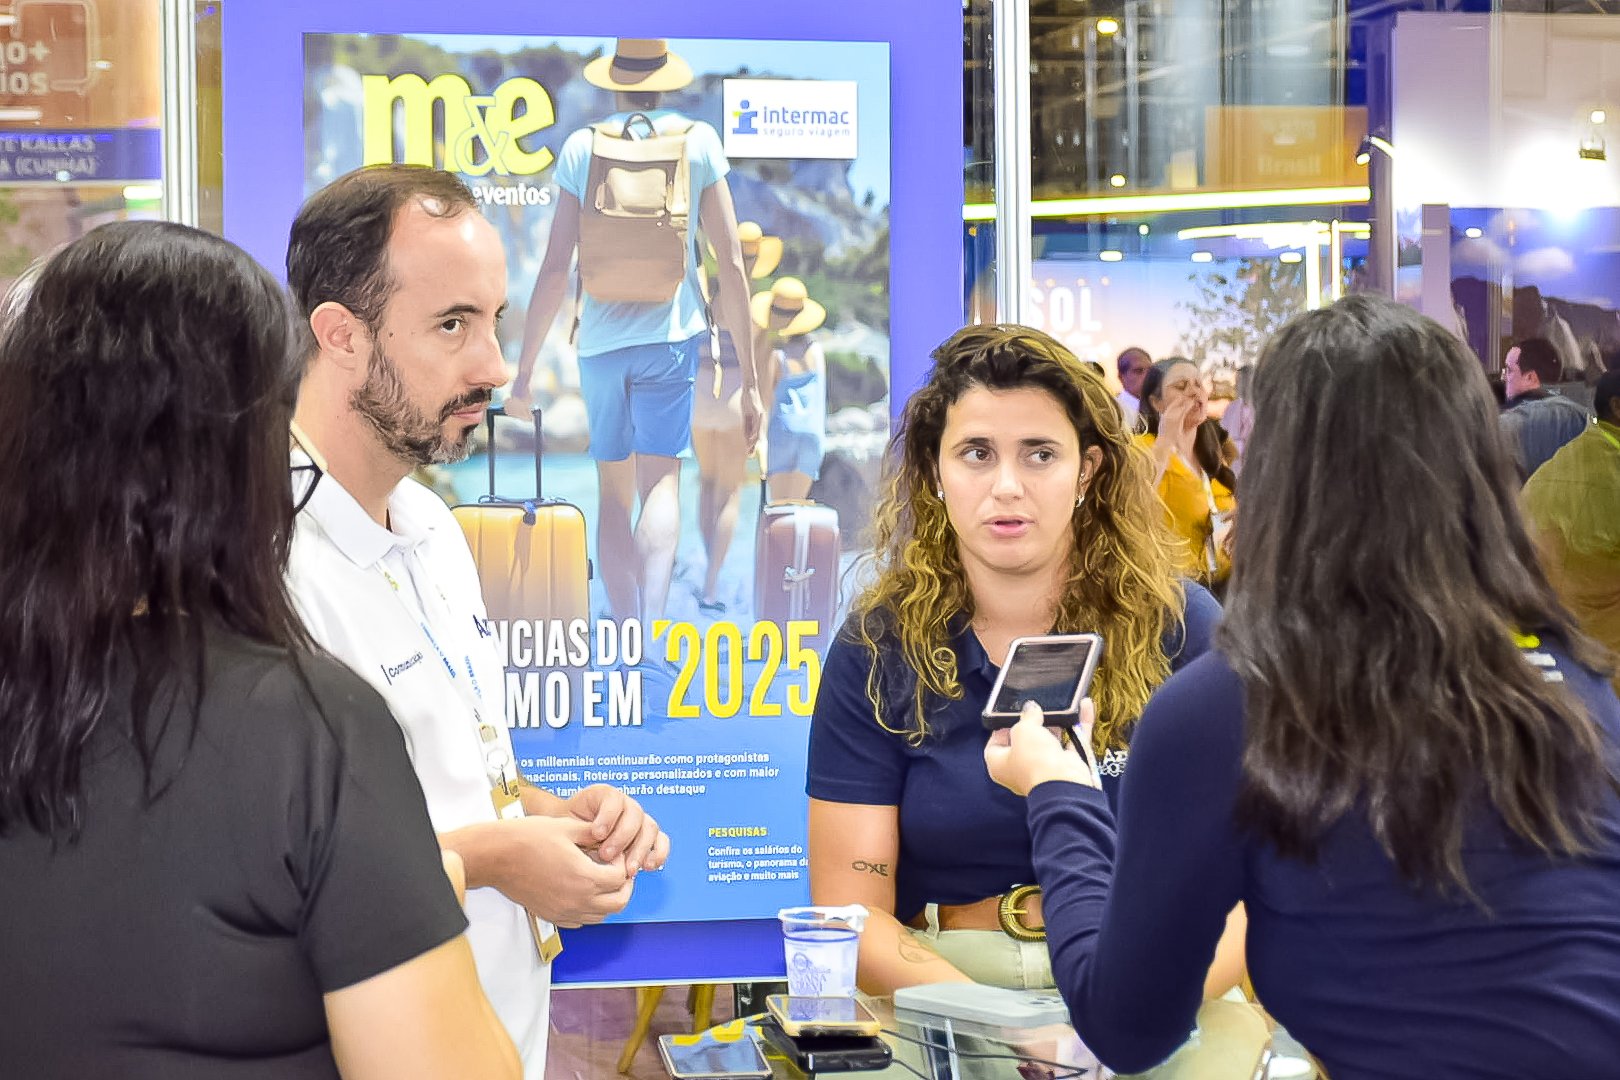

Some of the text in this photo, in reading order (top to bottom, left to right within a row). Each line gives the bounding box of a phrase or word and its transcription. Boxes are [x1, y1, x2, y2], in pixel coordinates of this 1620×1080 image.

[764, 106, 850, 125] intermac
[361, 73, 556, 176] m&e
[764, 127, 850, 139] seguro viagem
[472, 183, 551, 206] eventos
[1029, 286, 1104, 332] SOL
[596, 617, 644, 667] DO
[504, 670, 571, 729] MO
[582, 670, 644, 728] EM
[520, 751, 770, 768] os millennials continuarão como protagonistas
[583, 769, 629, 782] Roteiros
[631, 767, 713, 782] personalizados
[714, 769, 722, 778] e
[723, 768, 747, 778] com
[749, 766, 780, 777] maior
[656, 783, 706, 796] destaque
[707, 826, 768, 838] PESQUISAS
[707, 844, 803, 857] Confira os salários do
[708, 859, 745, 870] turismo,
[745, 860, 753, 869] o
[753, 858, 798, 870] panorama
[708, 869, 800, 884] aviação e muito mais
